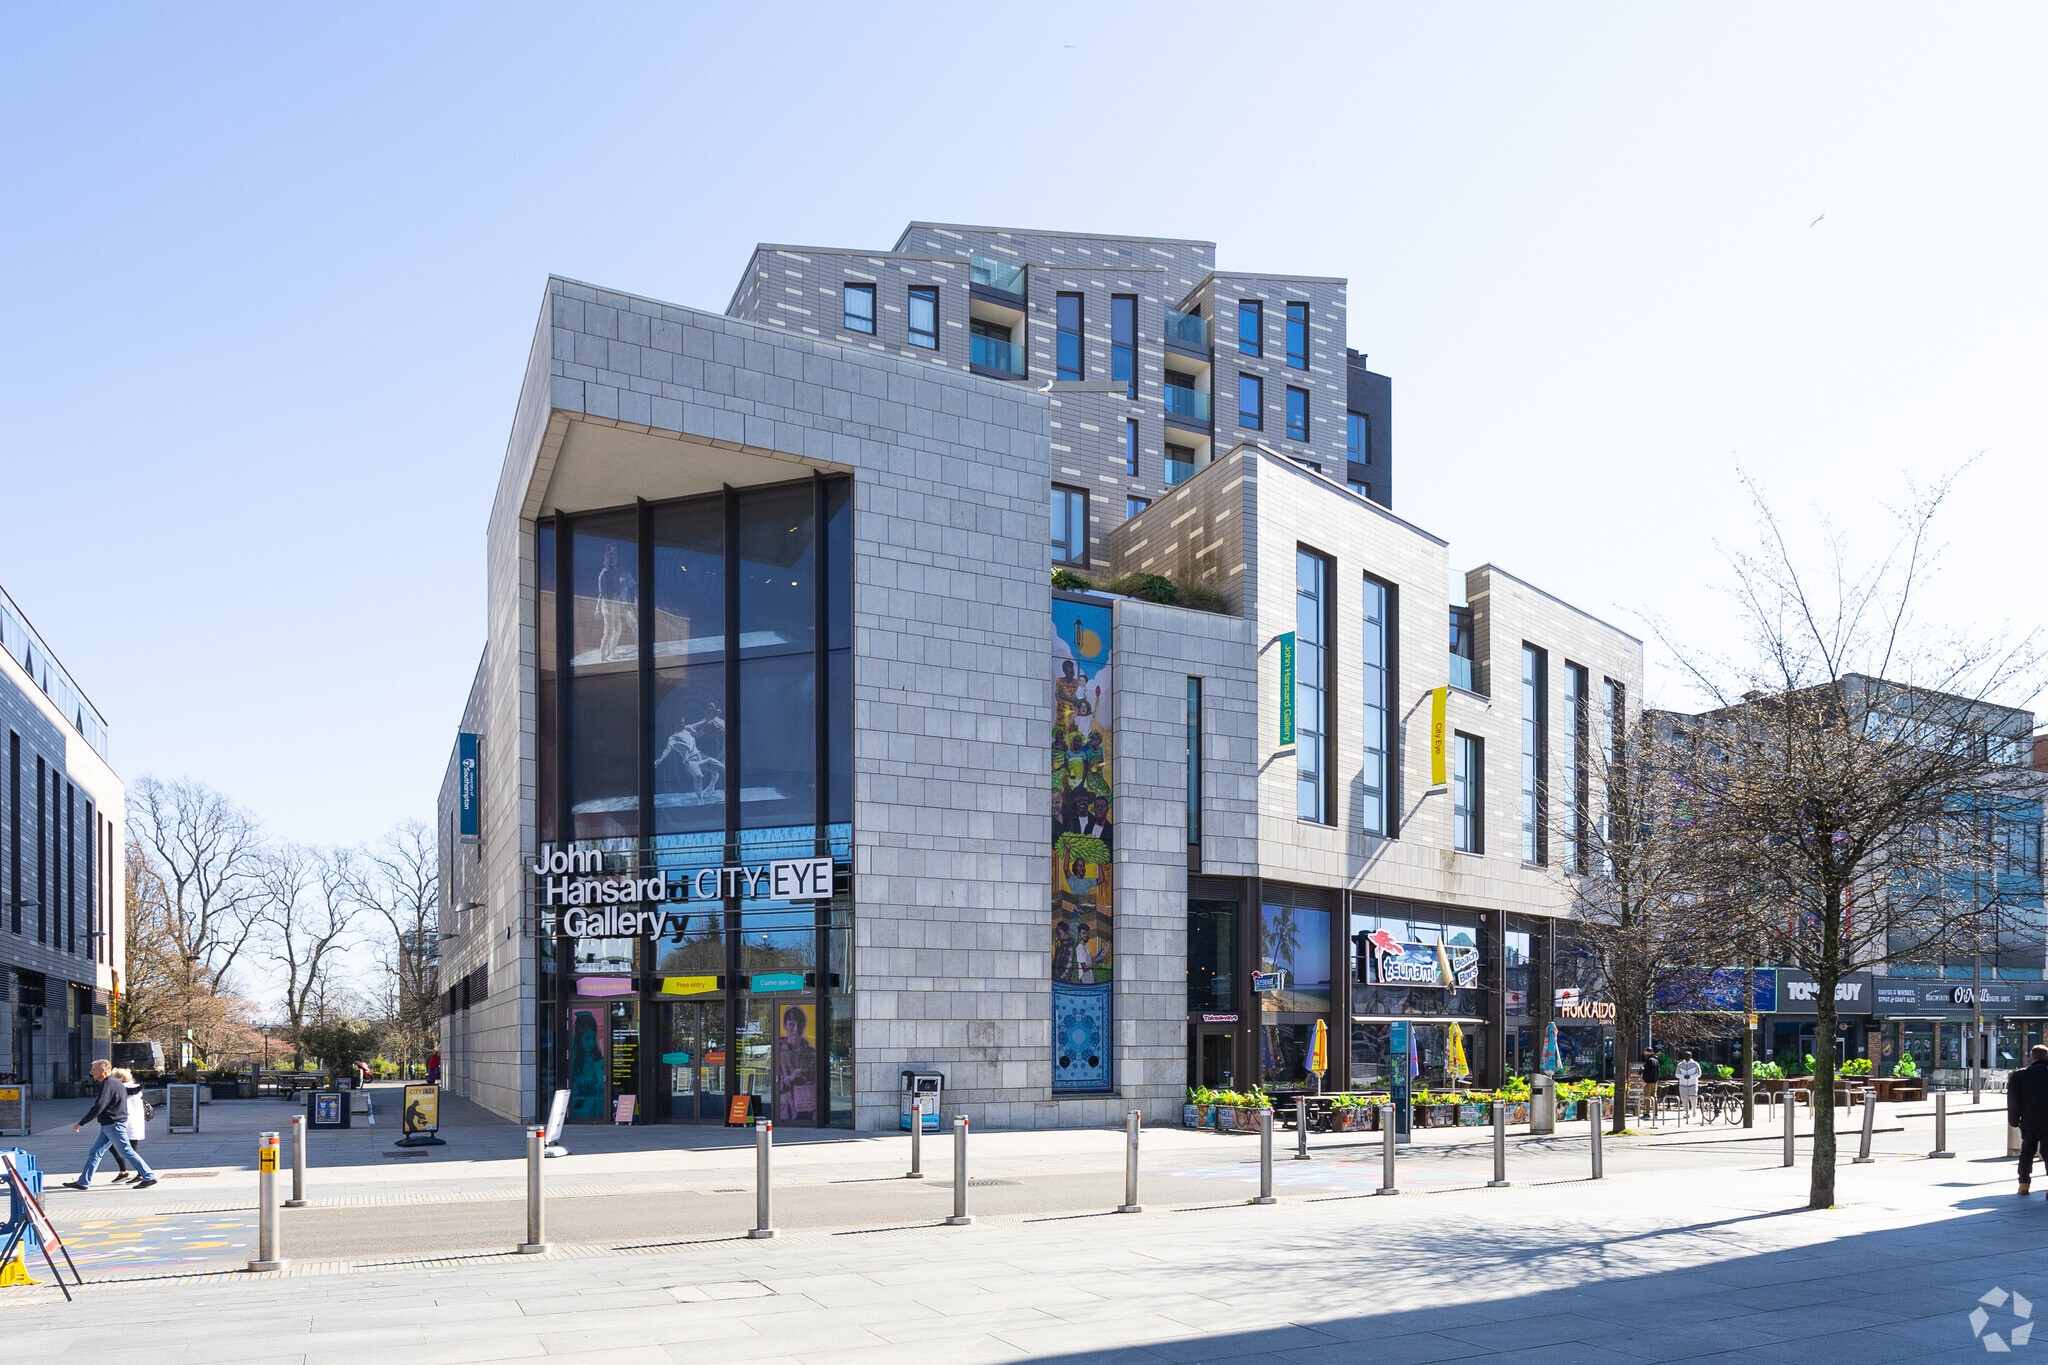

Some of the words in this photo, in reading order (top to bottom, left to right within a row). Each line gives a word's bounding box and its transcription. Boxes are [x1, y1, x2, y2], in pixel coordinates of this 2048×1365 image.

[1284, 644, 1292, 667] John
[1284, 668, 1292, 707] Hansard
[1283, 708, 1292, 741] Gallery
[1434, 722, 1443, 738] City
[1434, 739, 1443, 755] Eye
[462, 767, 470, 810] Southampton
[533, 844, 603, 876] John
[546, 871, 667, 906] Hansard
[695, 866, 765, 899] CITY
[773, 863, 830, 896] EYE
[563, 906, 669, 940] Gallery
[1384, 958, 1437, 983] tsunami
[1454, 950, 1479, 970] Beach
[676, 981, 690, 989] Free
[690, 982, 706, 990] entry
[759, 979, 778, 987] Come
[778, 979, 790, 987] join
[1459, 967, 1478, 984] Bars
[1787, 981, 1863, 1001] TONGUY
[1203, 1014, 1238, 1022] Takeaways
[1562, 1001, 1617, 1019] HOKKAIDO
